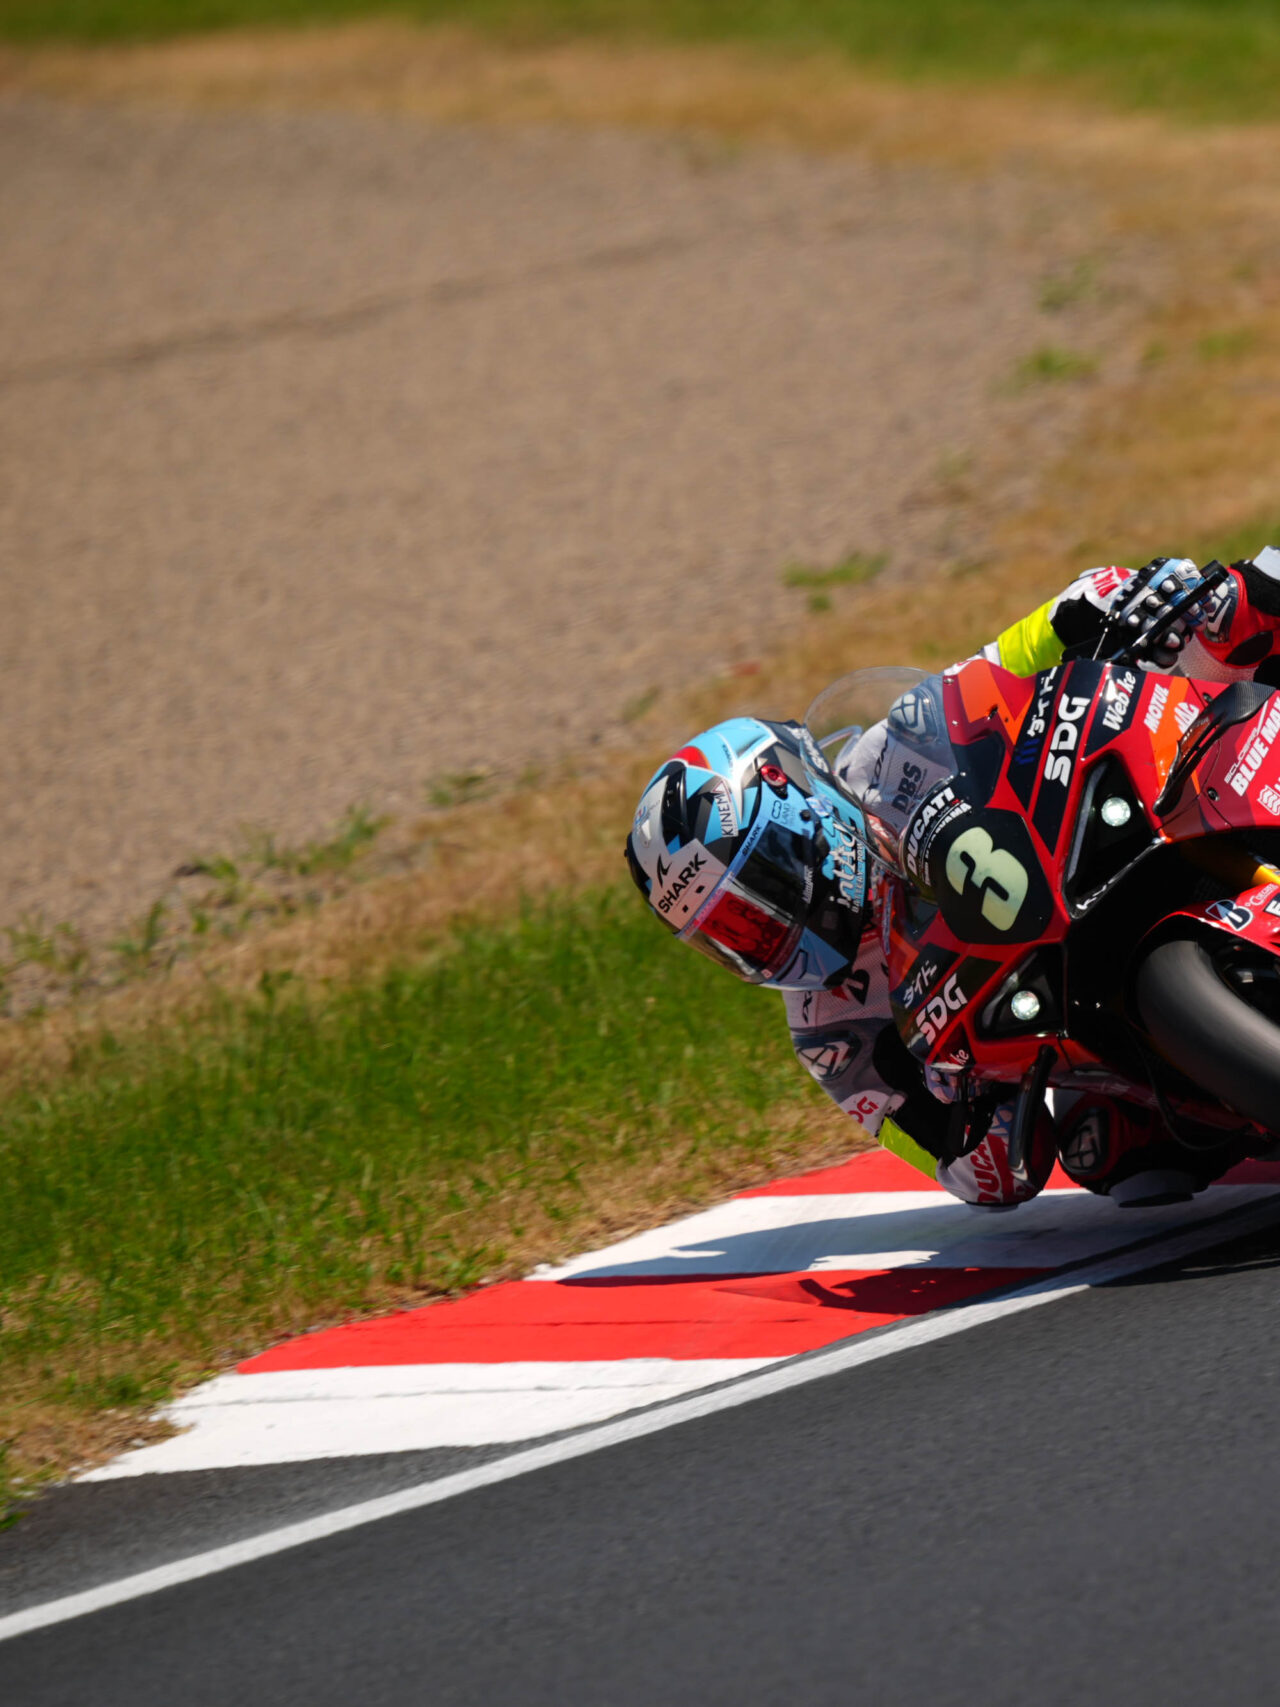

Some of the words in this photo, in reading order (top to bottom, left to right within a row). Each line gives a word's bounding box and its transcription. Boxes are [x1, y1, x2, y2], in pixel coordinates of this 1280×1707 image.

[1143, 682, 1170, 734] MOTUL
[1043, 693, 1091, 787] SDG
[1230, 736, 1270, 797] BLUE
[891, 761, 922, 815] DBS
[742, 824, 761, 857] SHARK
[907, 786, 955, 876] DUCATI
[657, 852, 708, 914] SHARK
[945, 826, 1029, 932] 3
[915, 972, 968, 1046] SDG
[847, 1095, 880, 1124] DG
